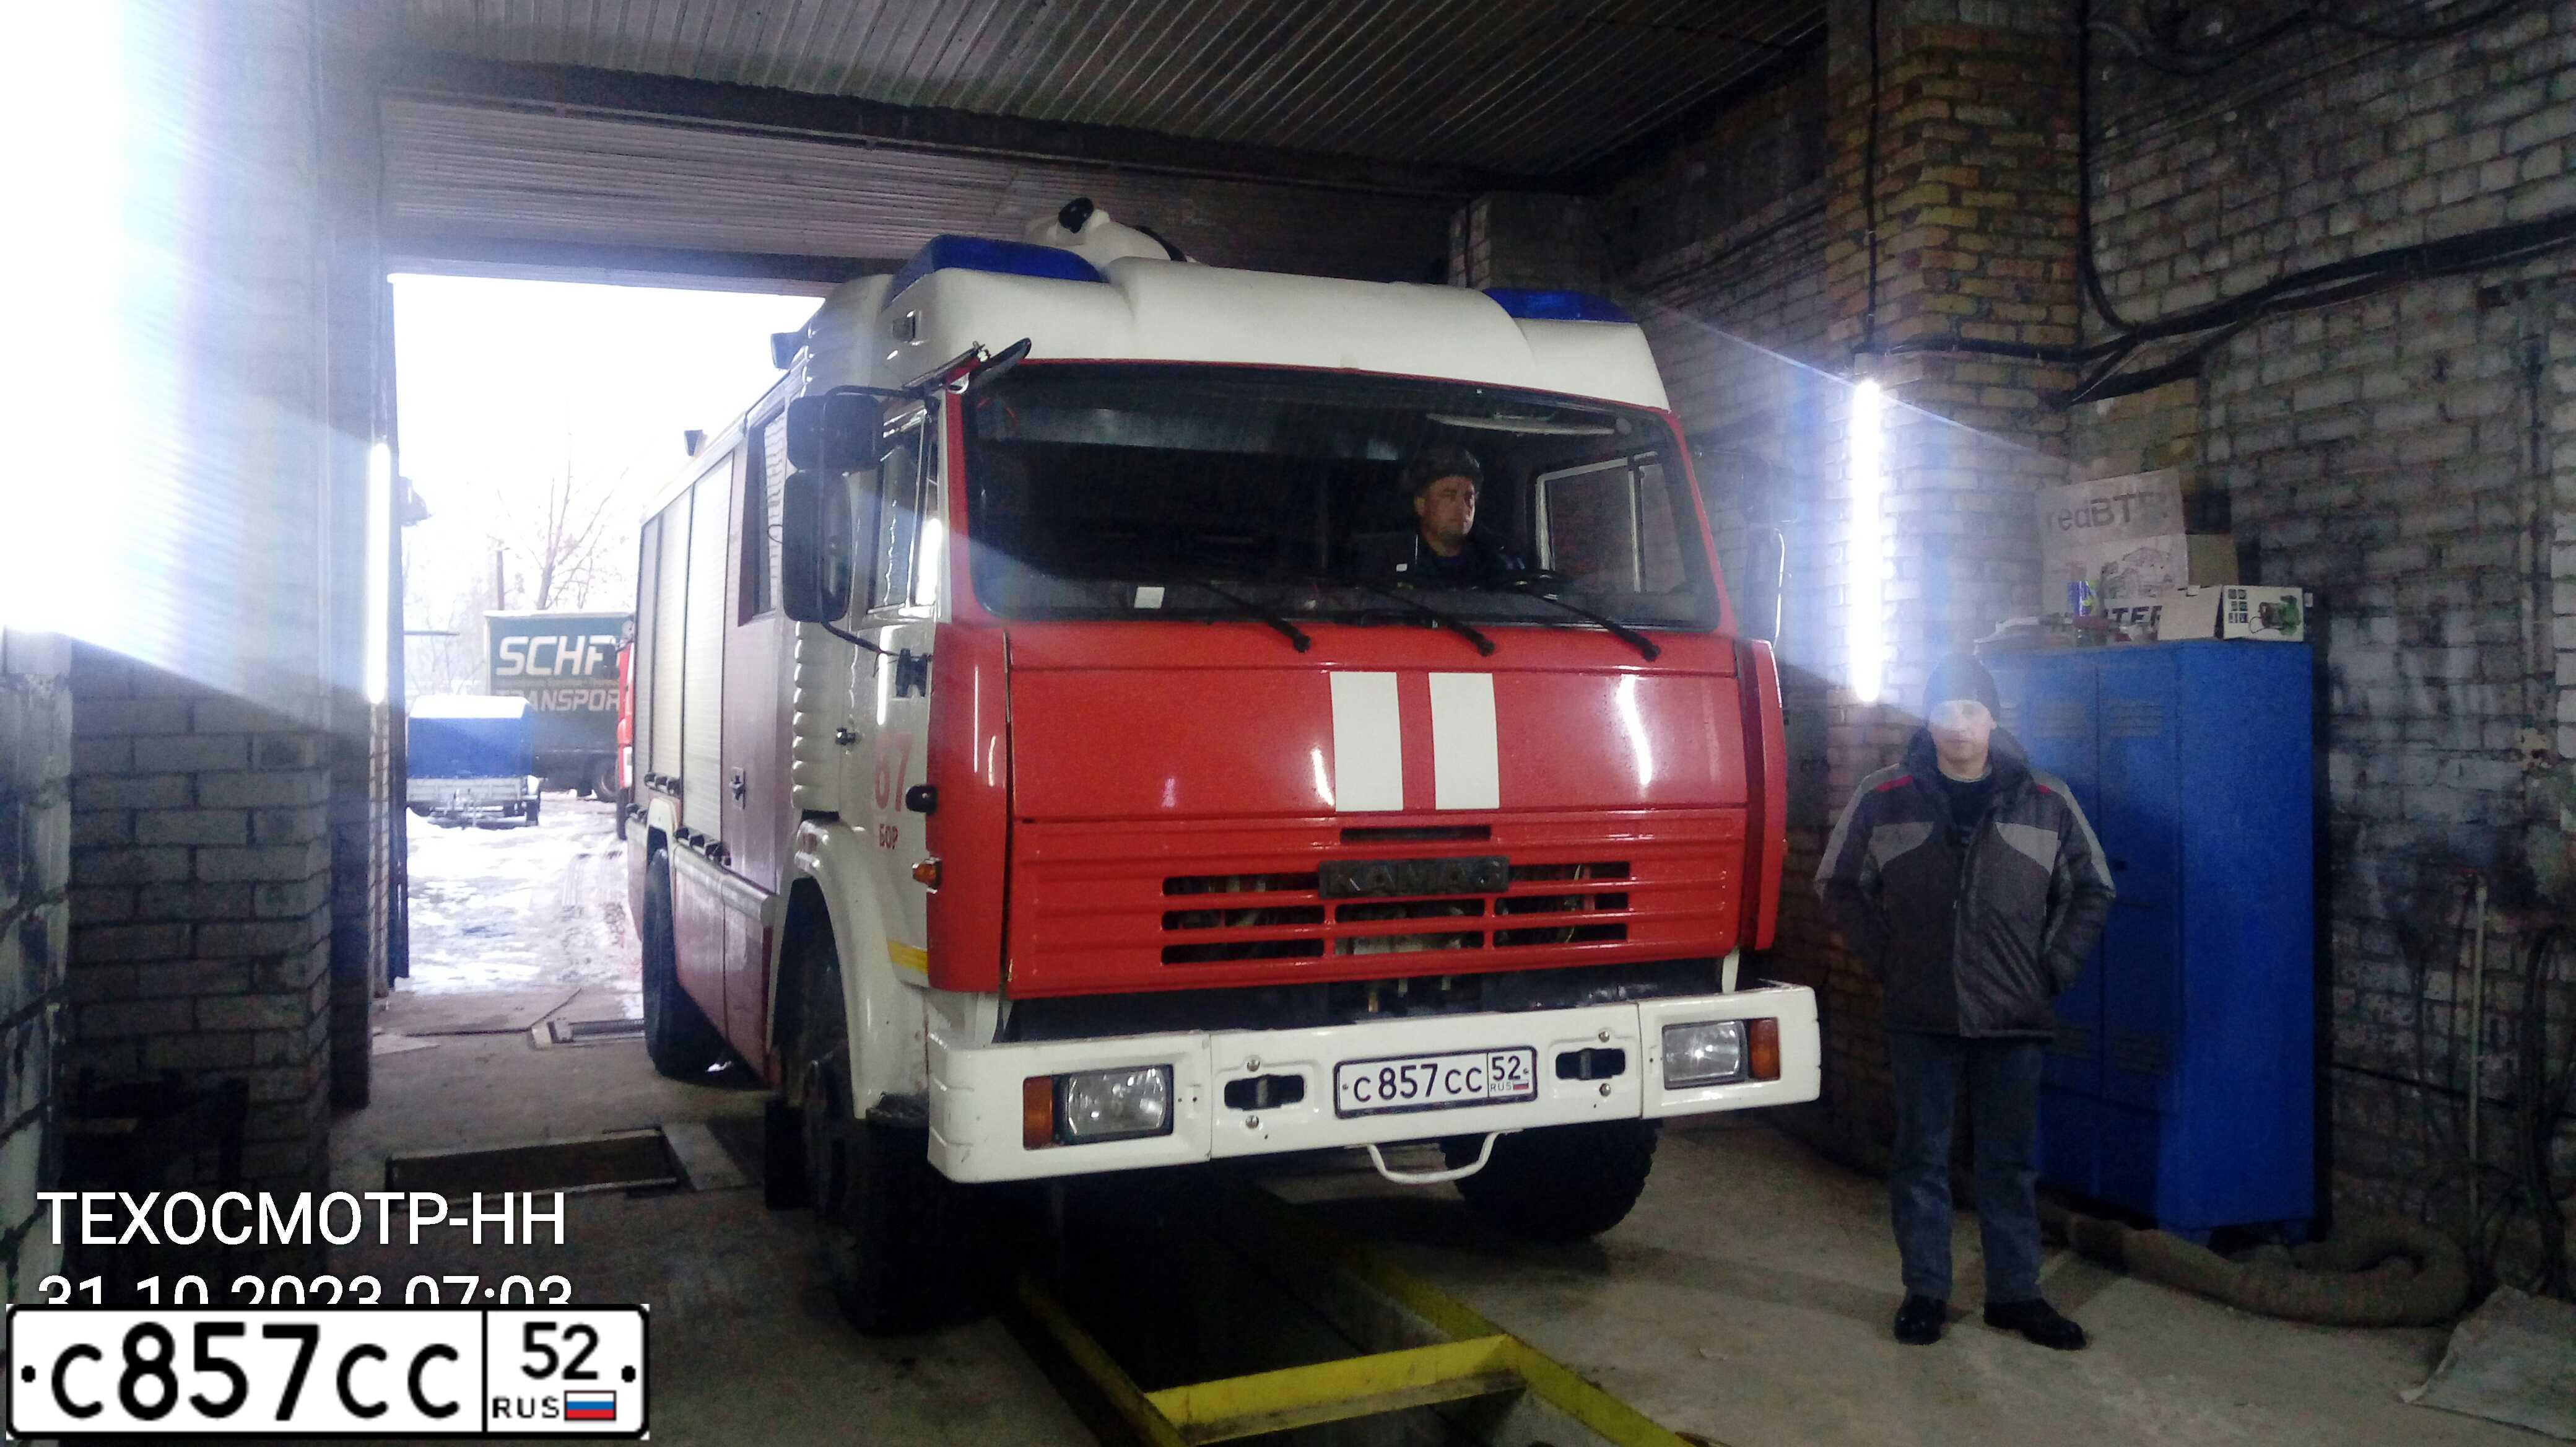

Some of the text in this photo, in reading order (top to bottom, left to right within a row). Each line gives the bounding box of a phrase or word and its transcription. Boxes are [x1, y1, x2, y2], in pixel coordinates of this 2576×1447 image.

[496, 635, 619, 675] SCH
[495, 689, 619, 712] ANSPOR
[1353, 1055, 1521, 1103] С857СС 52
[1490, 1080, 1512, 1092] RUS
